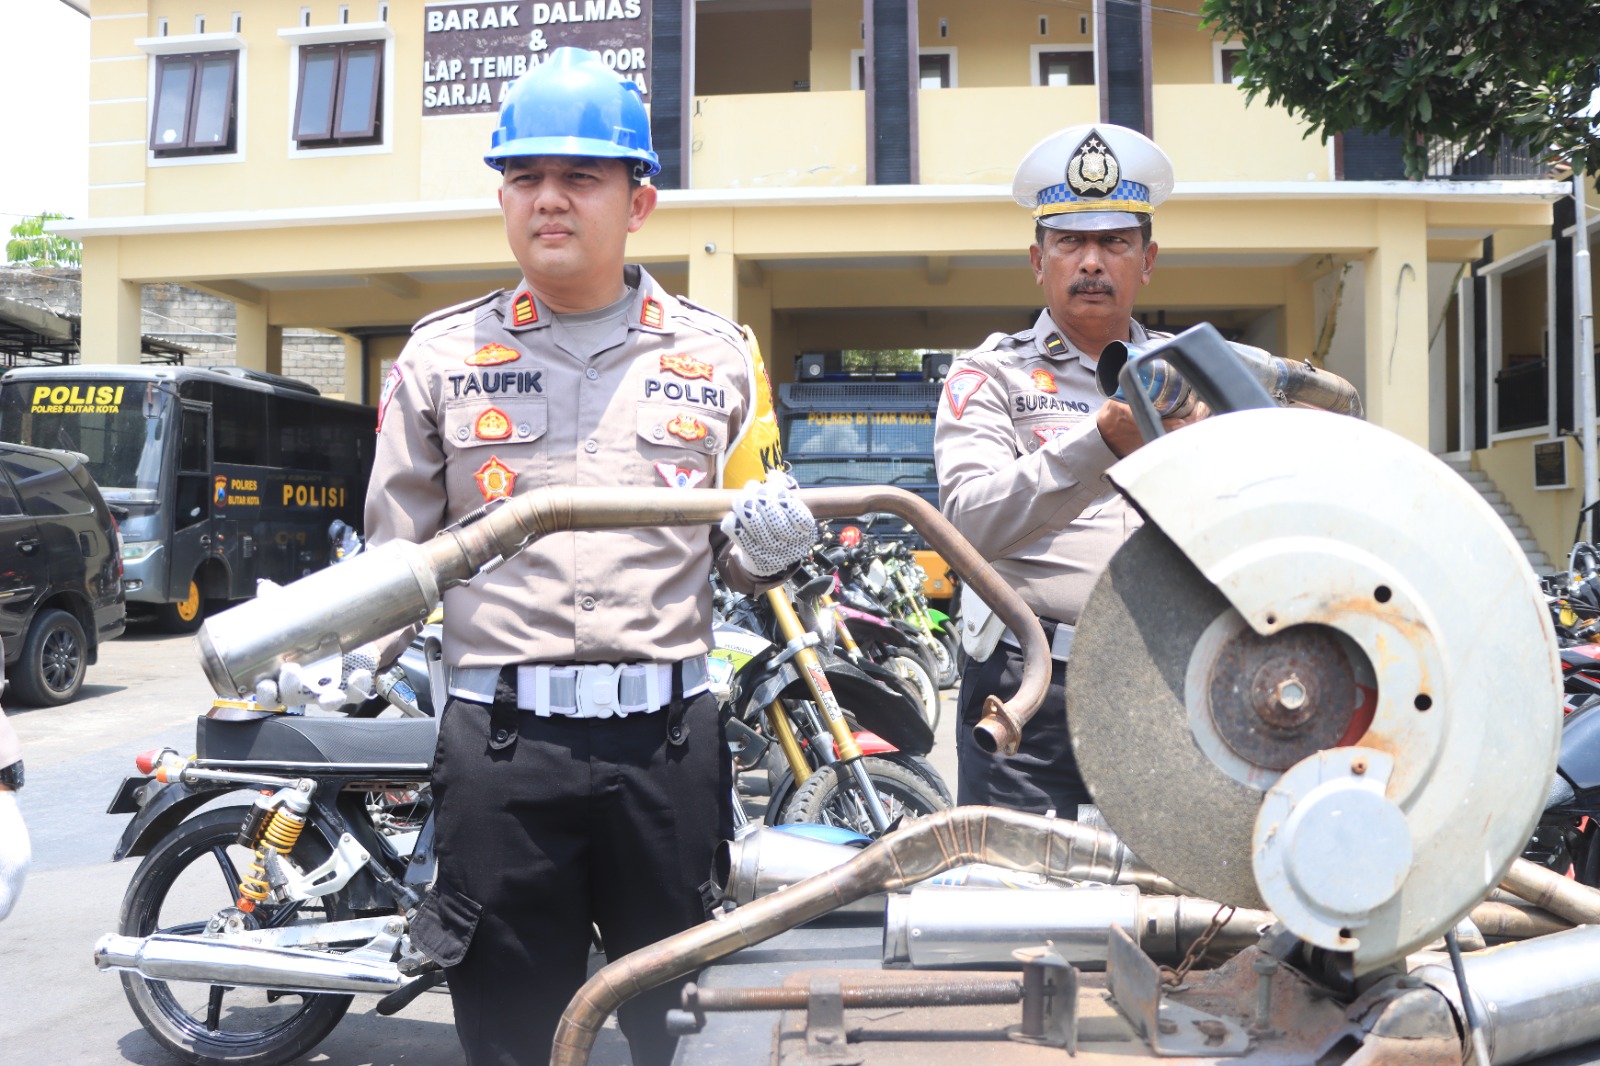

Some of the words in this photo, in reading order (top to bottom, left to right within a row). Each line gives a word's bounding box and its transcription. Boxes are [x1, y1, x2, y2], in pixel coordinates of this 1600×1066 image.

[427, 5, 520, 33] BARAK
[533, 0, 642, 25] DALMAS
[529, 29, 548, 51] &
[424, 59, 466, 83] LAP.
[424, 82, 492, 108] SARJA
[448, 371, 543, 397] TAUFIK
[645, 378, 726, 409] POLRI
[32, 386, 125, 405] POLISI
[1015, 396, 1090, 413] SURATNO
[31, 405, 64, 413] POLRES
[64, 405, 95, 413] BLITAR
[95, 405, 119, 413] KOTA
[808, 412, 853, 426] POLRES
[900, 412, 931, 425] KOTA
[231, 479, 257, 490] POLRES
[283, 484, 345, 507] POLISI
[228, 495, 246, 505] BLITAR
